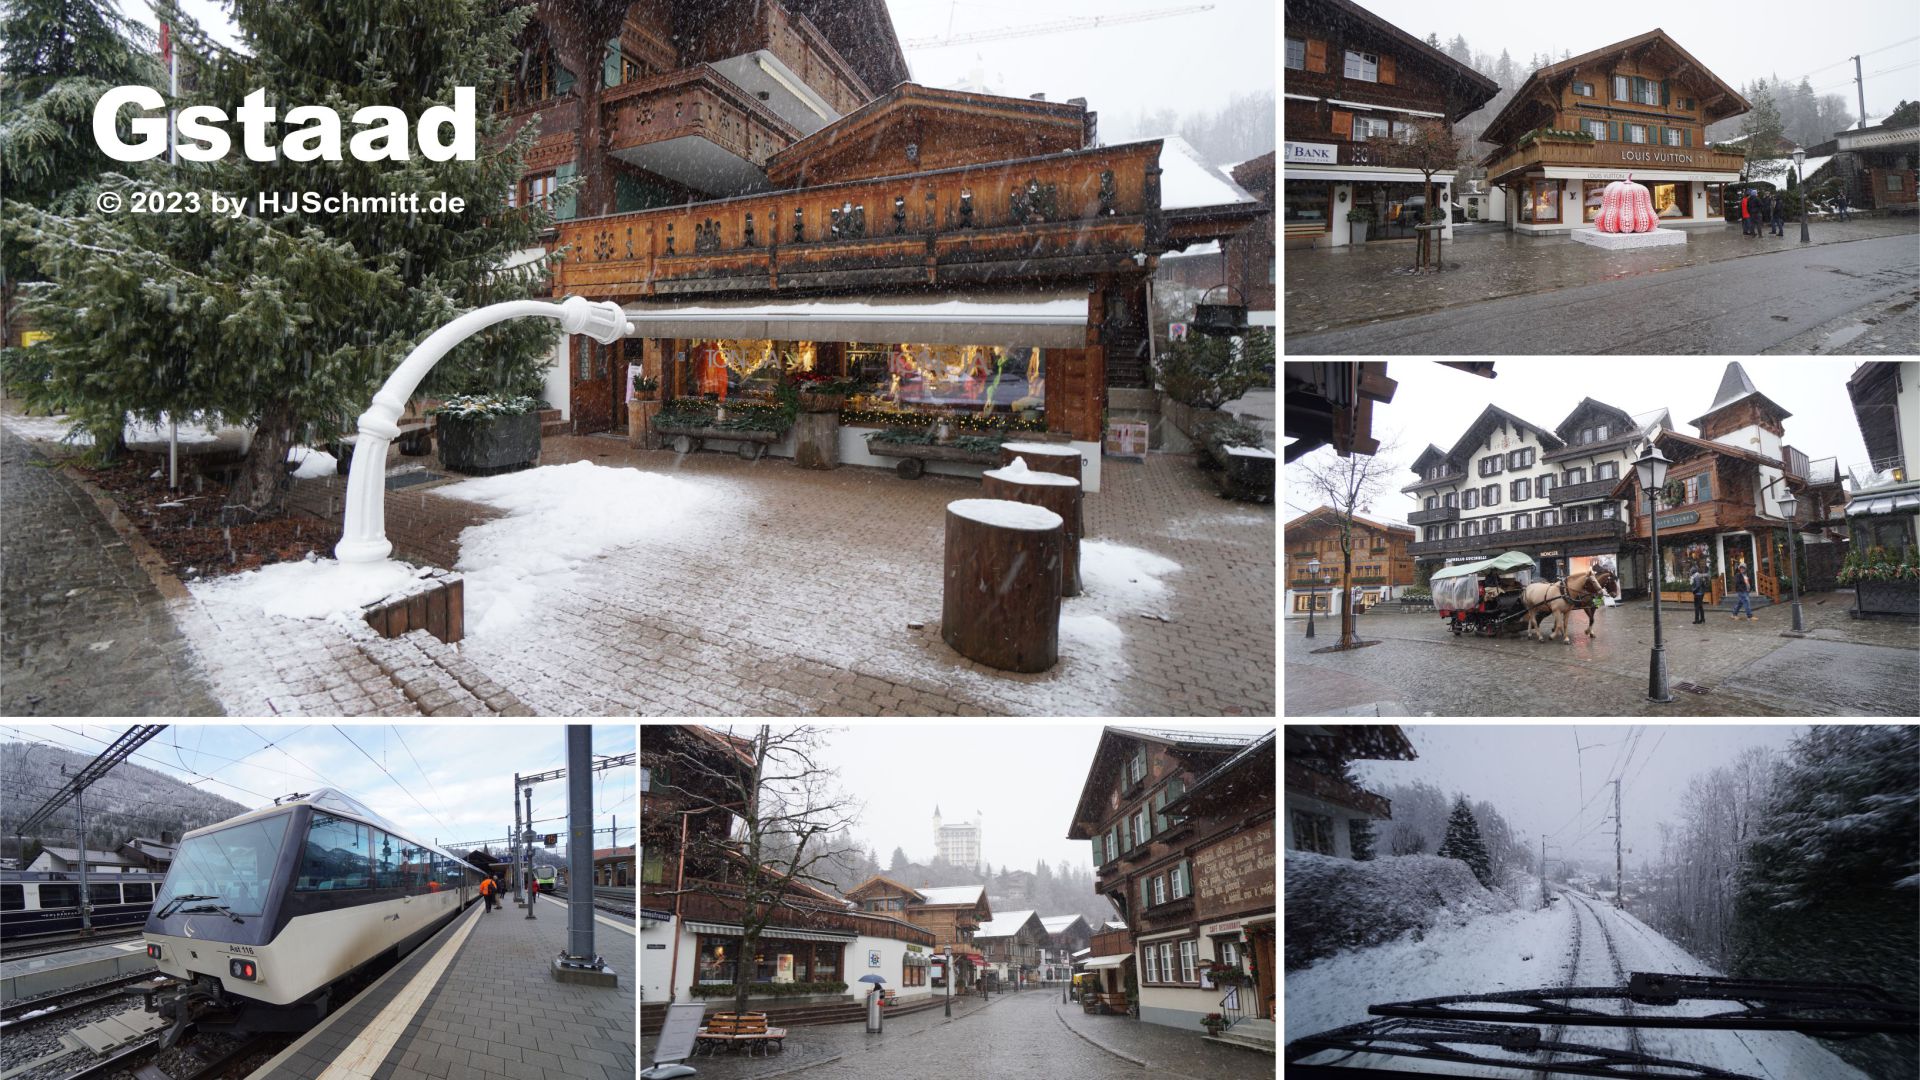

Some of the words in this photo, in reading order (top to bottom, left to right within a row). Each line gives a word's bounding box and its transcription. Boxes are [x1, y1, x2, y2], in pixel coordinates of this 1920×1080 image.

[1294, 146, 1329, 158] BANK
[1621, 150, 1650, 162] LOUIS
[1653, 151, 1693, 163] VUITTON
[230, 944, 241, 953] Ast
